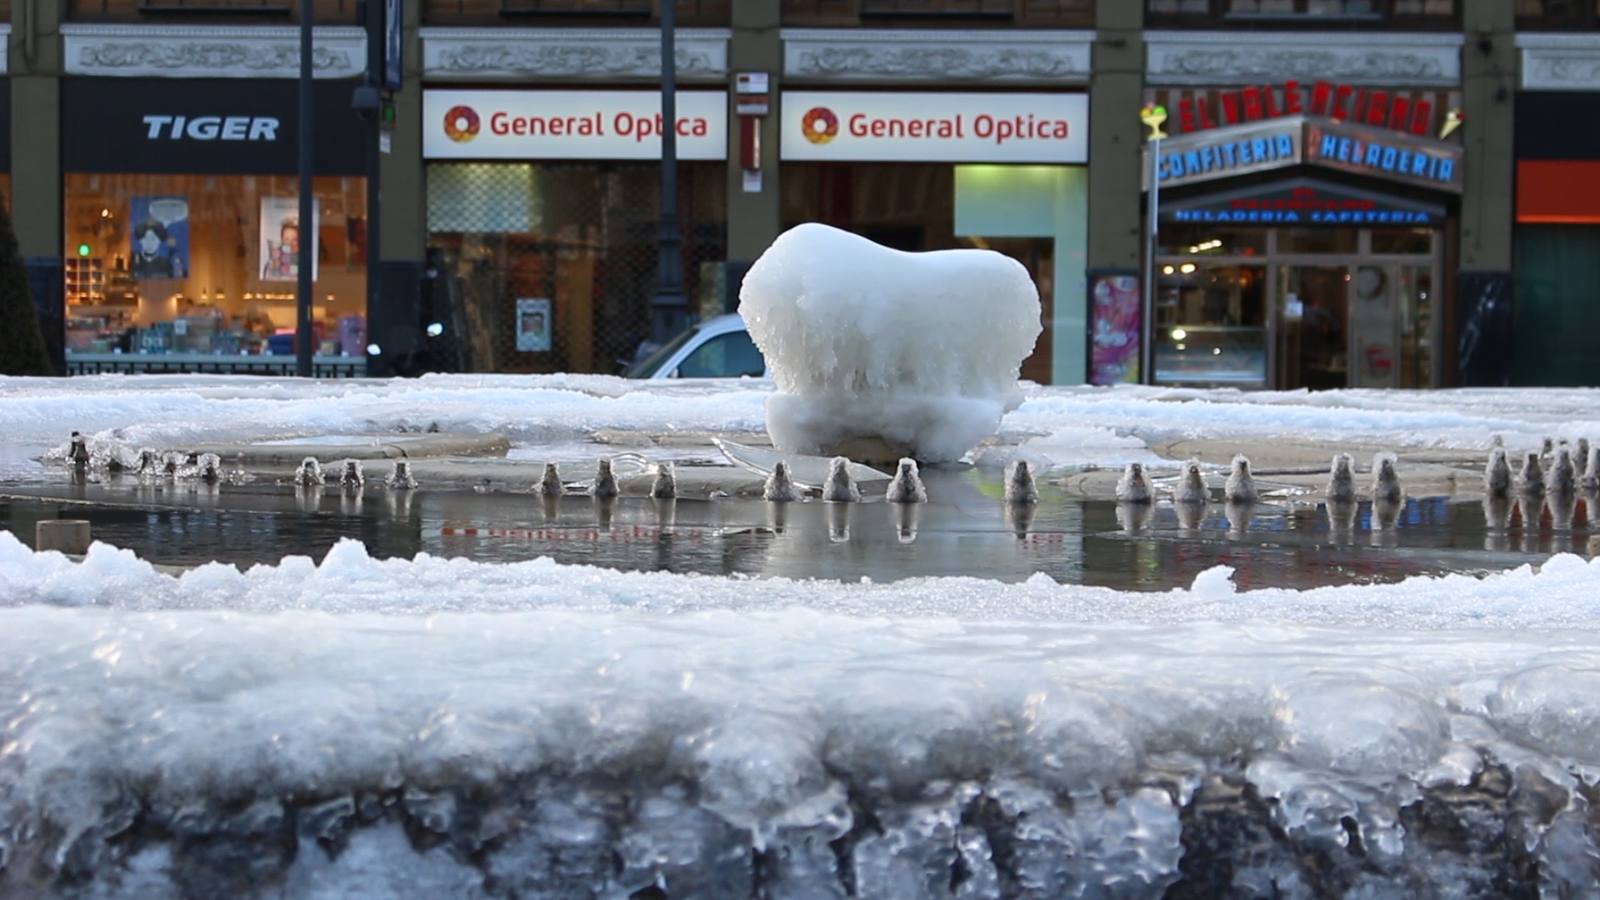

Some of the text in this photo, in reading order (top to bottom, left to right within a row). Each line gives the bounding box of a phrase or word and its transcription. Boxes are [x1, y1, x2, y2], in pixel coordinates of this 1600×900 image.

[143, 115, 280, 140] TIGER
[490, 112, 708, 142] General Optca
[849, 113, 1068, 145] General Optica
[1178, 97, 1216, 133] EL
[1158, 133, 1294, 180] CONFITERIA
[1321, 133, 1455, 182] HELADERIA
